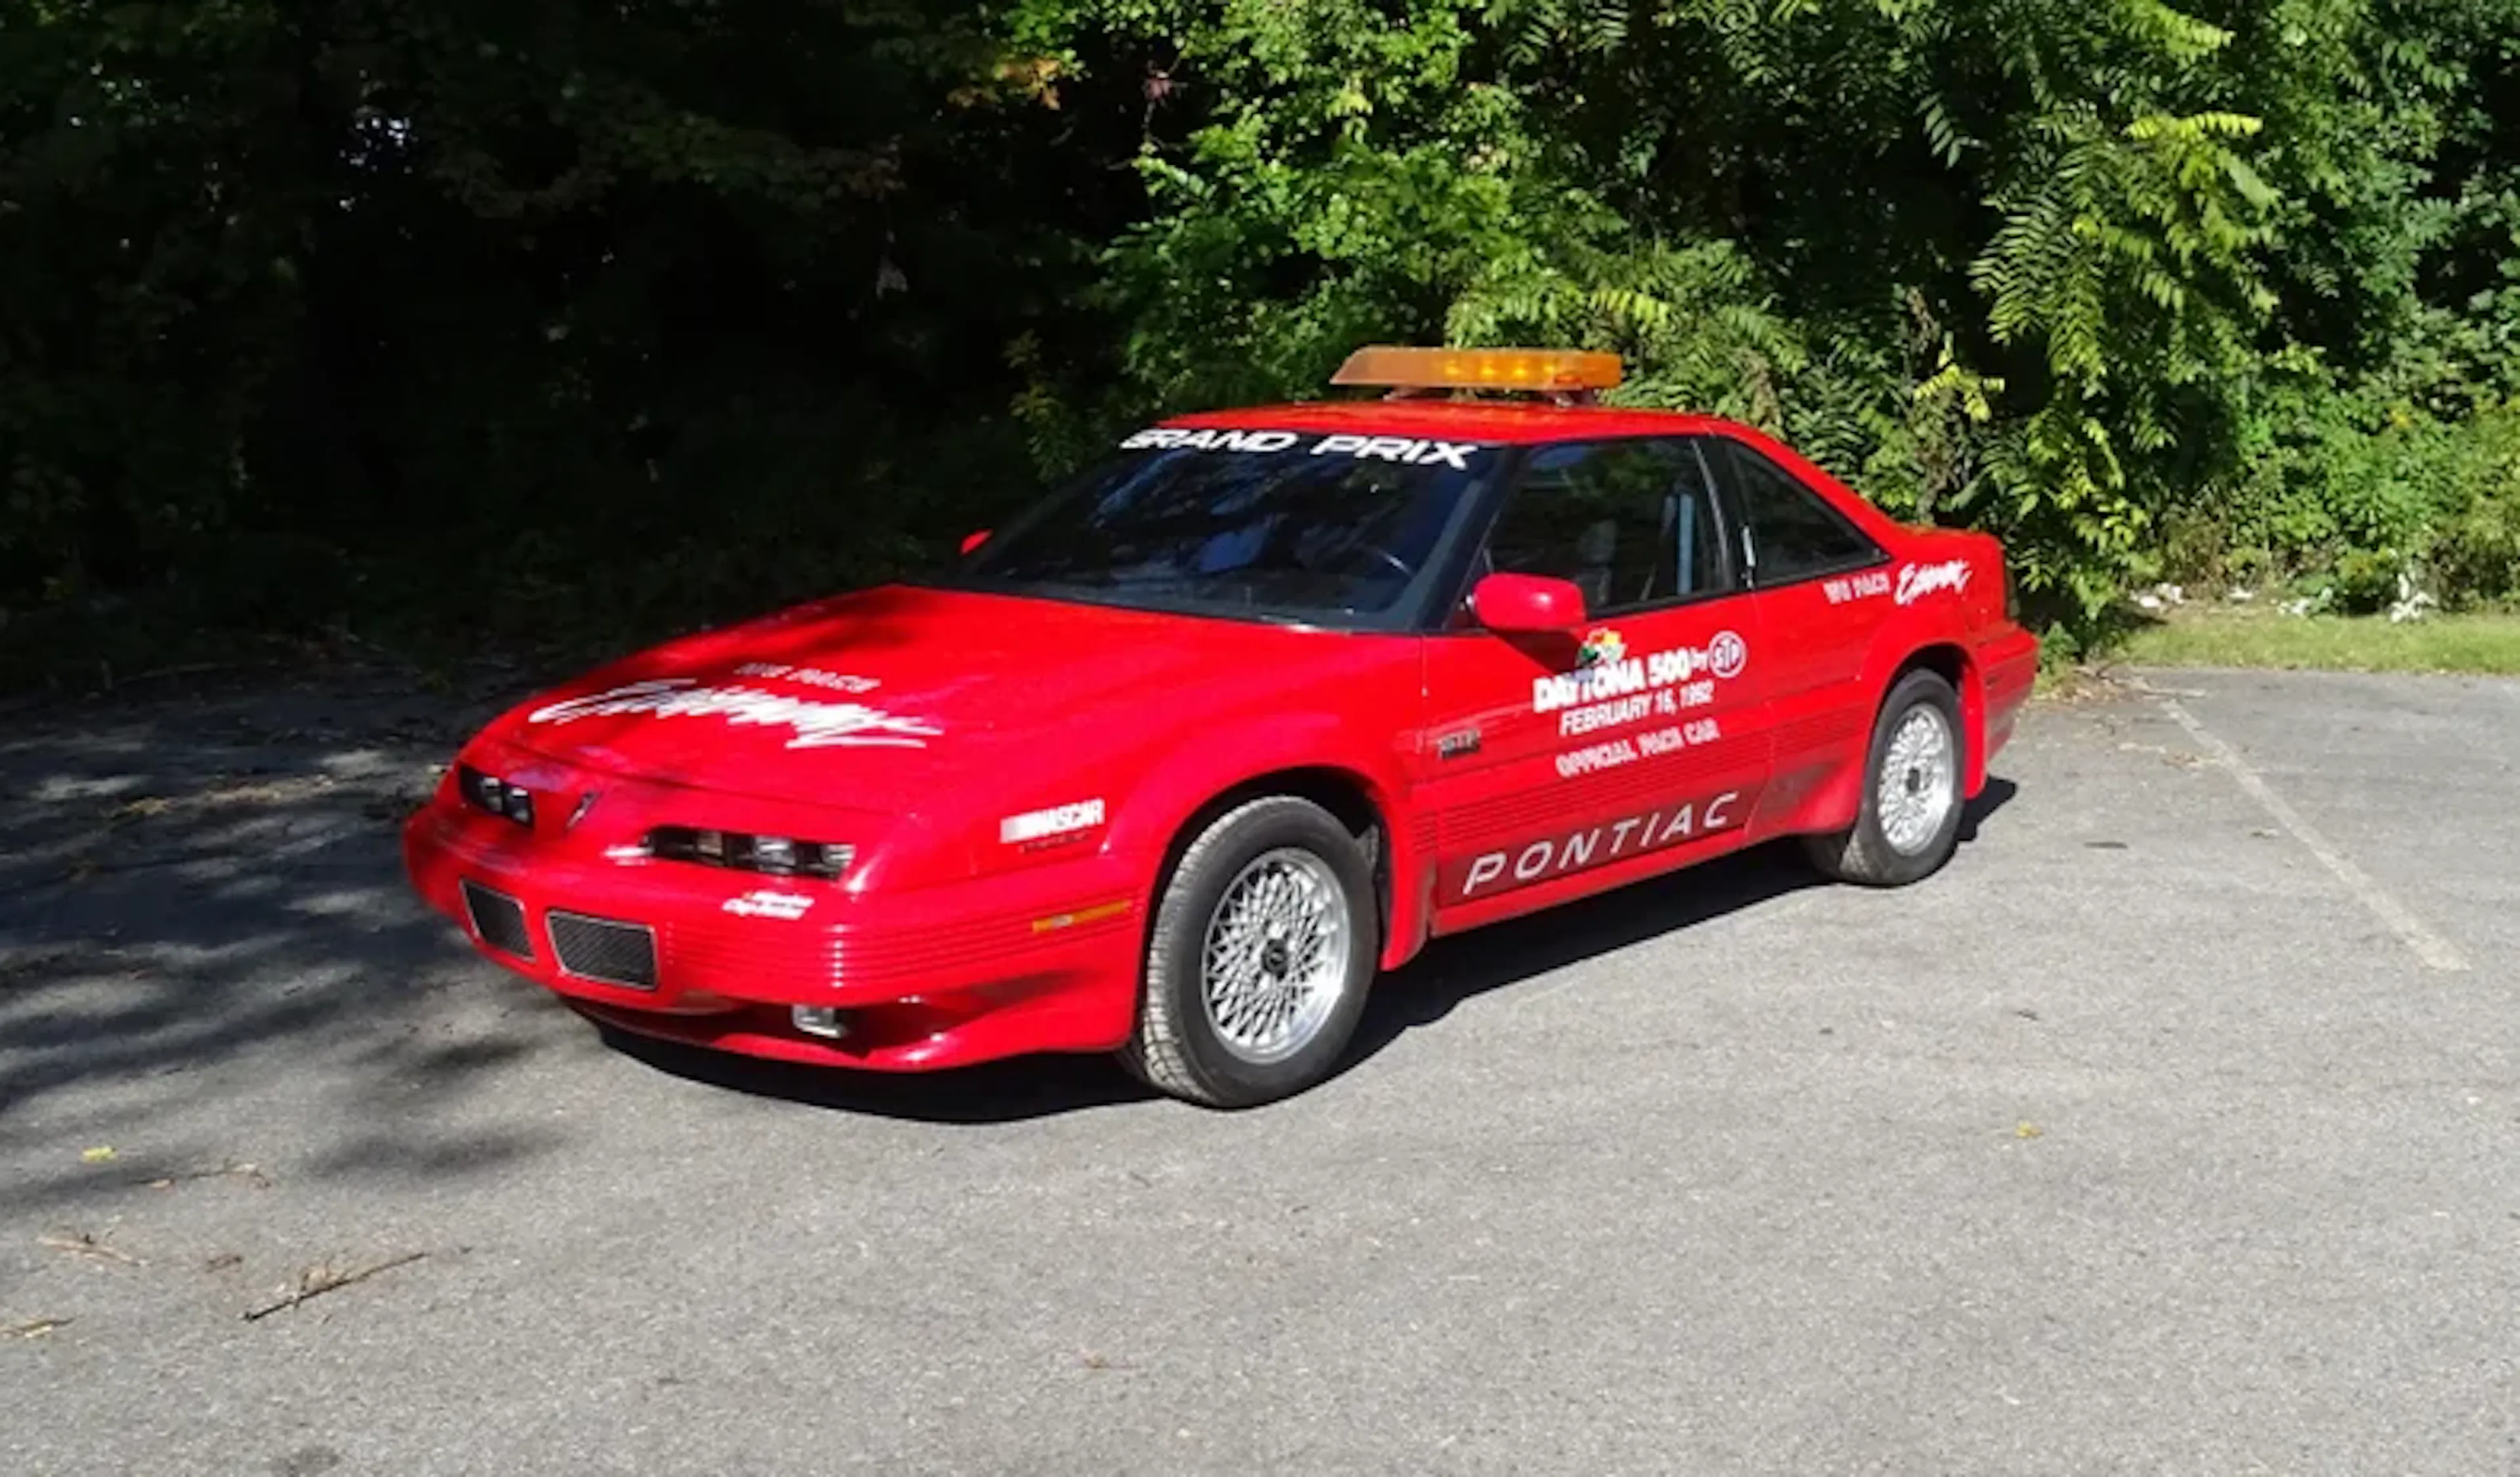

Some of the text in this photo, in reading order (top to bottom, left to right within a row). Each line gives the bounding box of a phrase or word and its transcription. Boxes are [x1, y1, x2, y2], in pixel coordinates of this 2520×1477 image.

[1119, 428, 1478, 470] GRAND PRIX
[1533, 658, 1646, 713] DAYTONA
[1647, 647, 1691, 687] 500
[1559, 692, 1652, 736] FEBRUARY
[1555, 739, 1638, 778] OFFICIAL
[1684, 717, 1721, 745] CAR
[1461, 791, 1738, 895] PONTIAC
